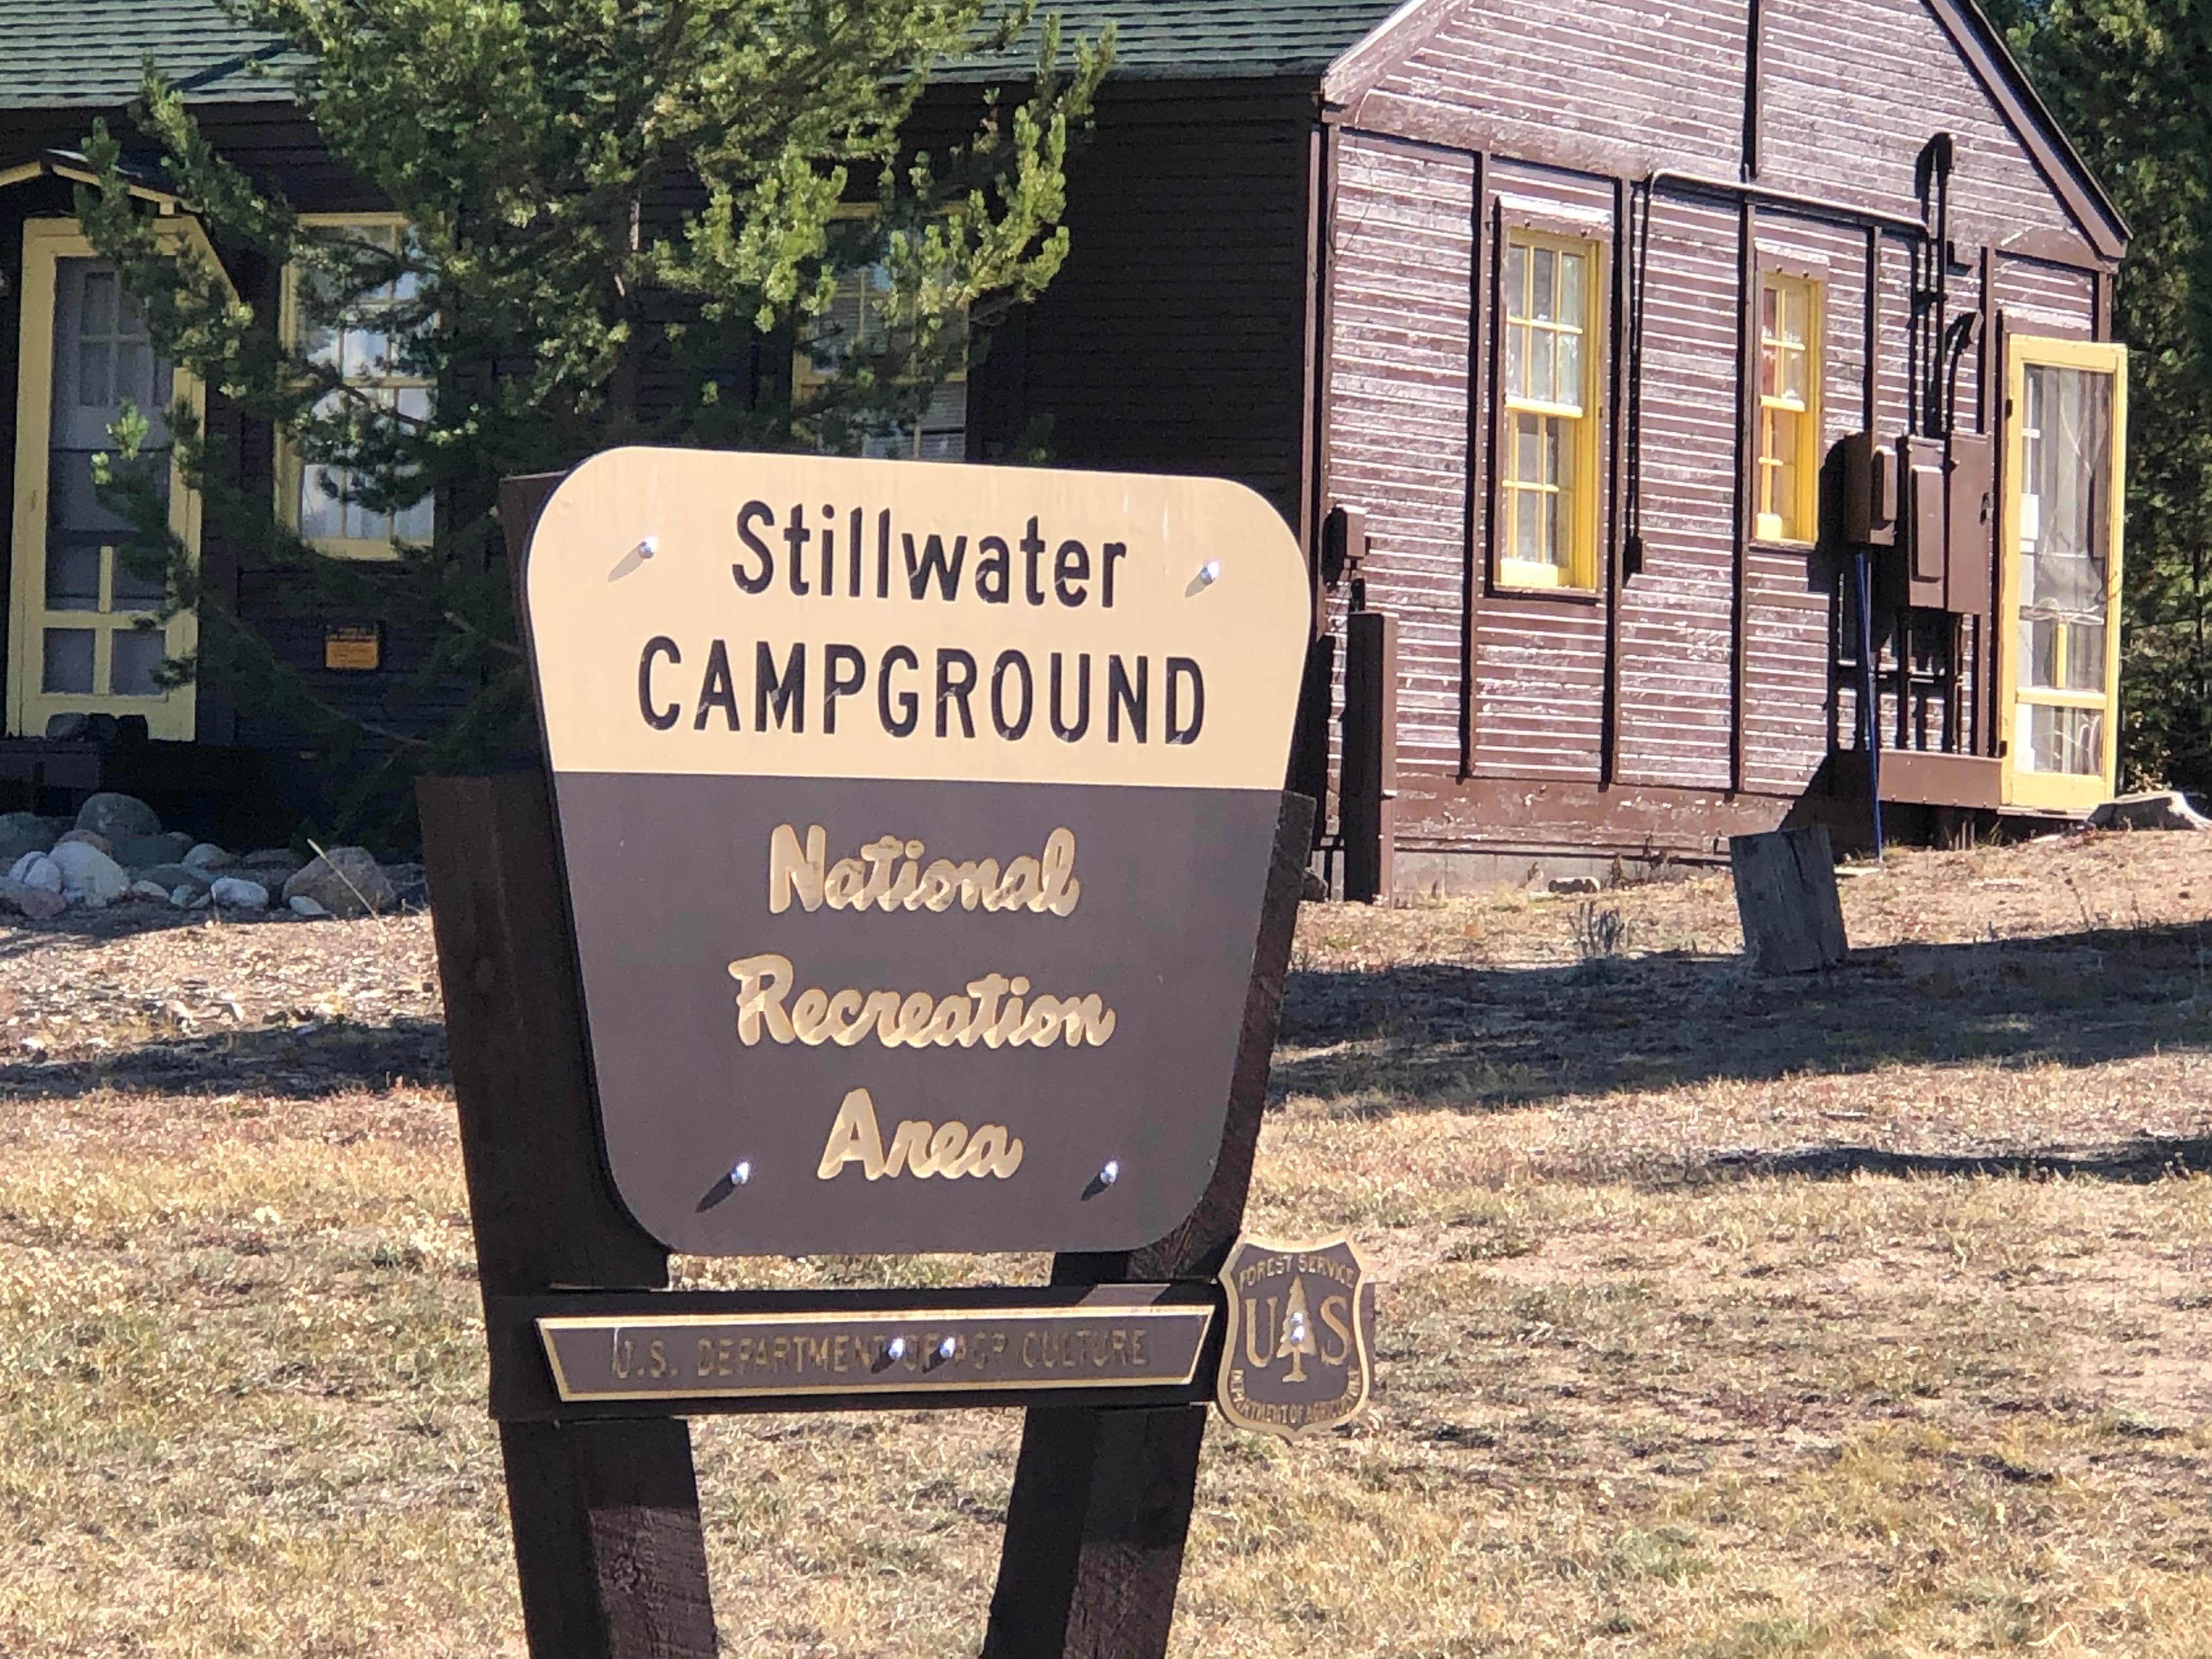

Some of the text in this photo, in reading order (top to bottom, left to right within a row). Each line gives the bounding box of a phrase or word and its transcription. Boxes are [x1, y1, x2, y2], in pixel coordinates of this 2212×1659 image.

[731, 500, 1127, 608] Stillwater
[638, 635, 1205, 745] CAMPGROUND
[769, 823, 1080, 918] National
[727, 953, 1116, 1050] Recreation
[816, 1087, 1024, 1182] Area
